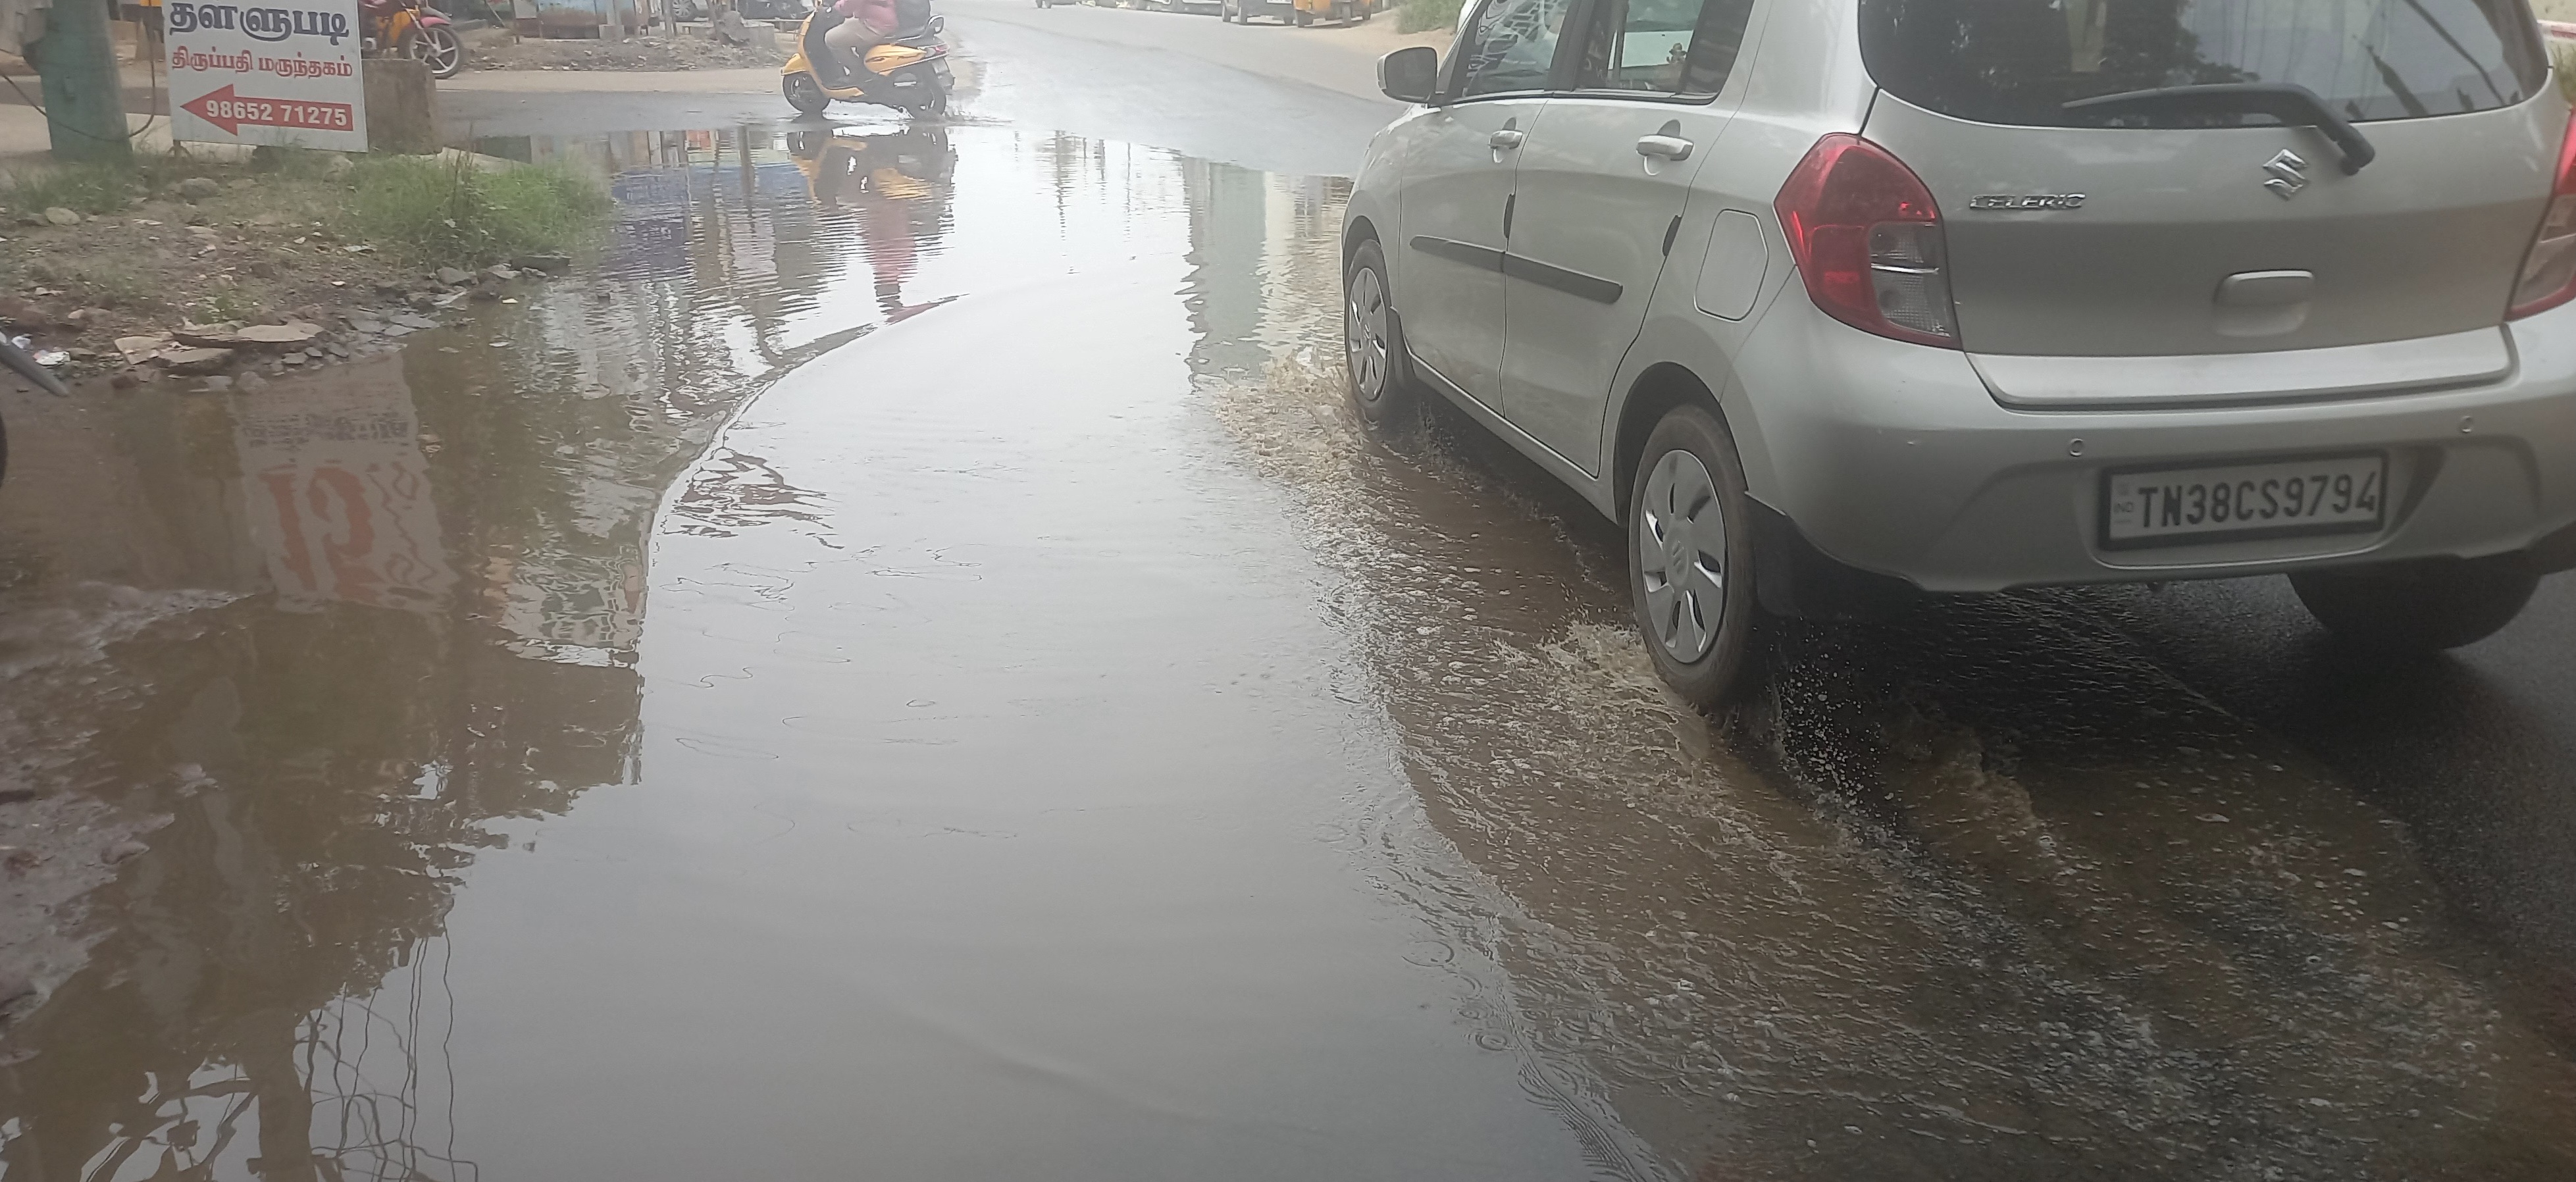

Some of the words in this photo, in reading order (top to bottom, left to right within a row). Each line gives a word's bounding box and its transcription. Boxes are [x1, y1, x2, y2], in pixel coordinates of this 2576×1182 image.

[172, 46, 253, 73] திருப்பதி
[258, 52, 353, 78] மருந்தகம்
[206, 100, 272, 121] 98652
[280, 104, 347, 126] 71275
[2138, 471, 2377, 527] TN38CS9794
